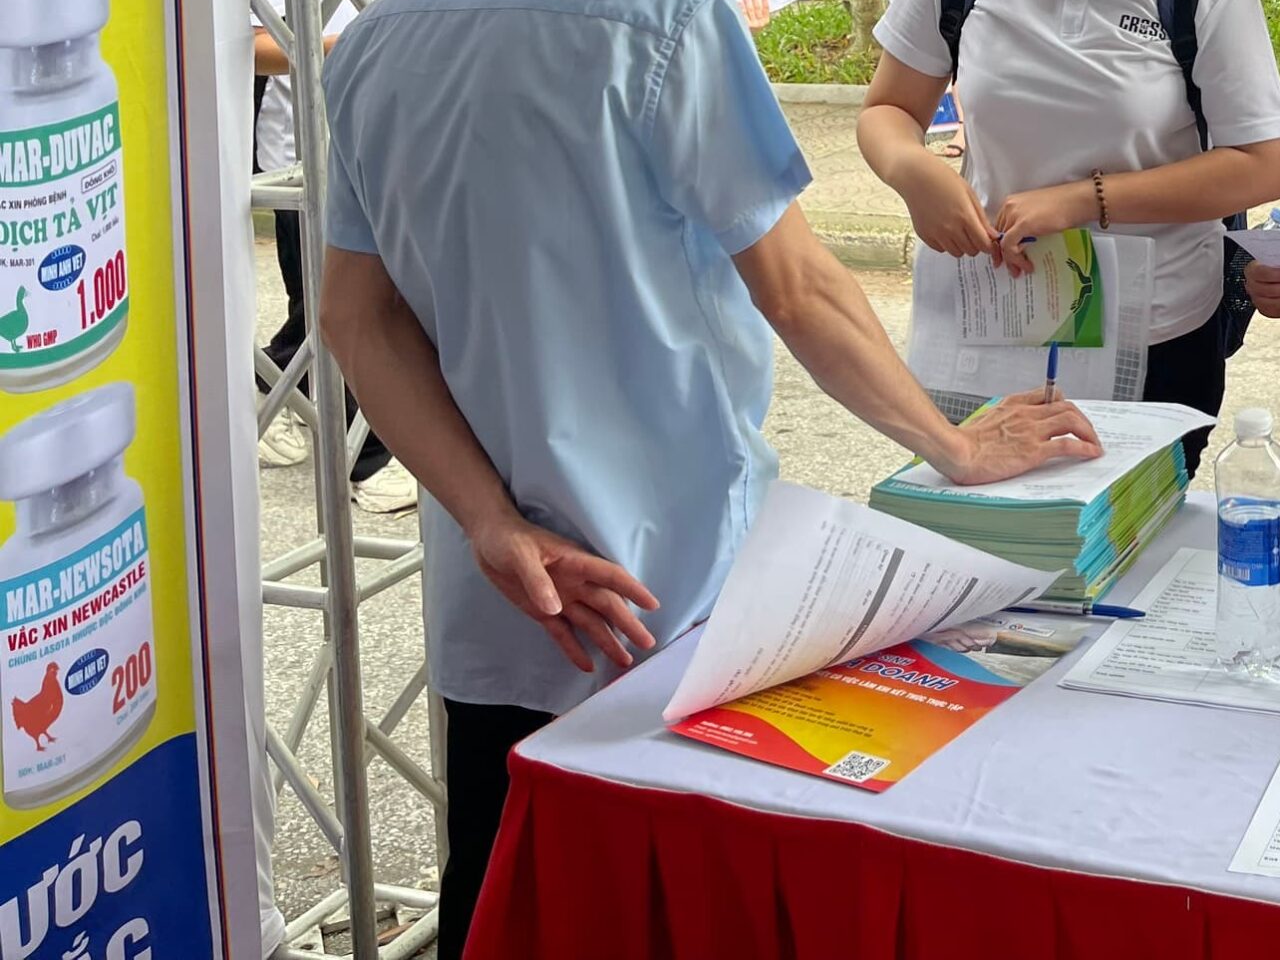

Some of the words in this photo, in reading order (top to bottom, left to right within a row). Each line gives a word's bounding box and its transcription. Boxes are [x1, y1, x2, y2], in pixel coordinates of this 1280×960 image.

[9, 199, 22, 209] XIN
[24, 196, 47, 208] PHÒNG
[48, 190, 67, 205] BỆNH
[53, 197, 82, 238] TẢ
[86, 182, 118, 221] VỊT
[59, 258, 72, 278] ANH
[72, 252, 83, 271] VET
[77, 249, 126, 330] 1.000
[27, 334, 42, 349] WHO
[43, 329, 58, 348] GMP
[6, 520, 145, 623] MAR-NEWSOTA
[8, 626, 38, 651] VẮC
[43, 615, 68, 640] XIN
[72, 561, 146, 627] NEWCASTLE
[39, 637, 70, 658] LASOTA
[111, 641, 152, 715] 200
[861, 662, 960, 691] DOANH
